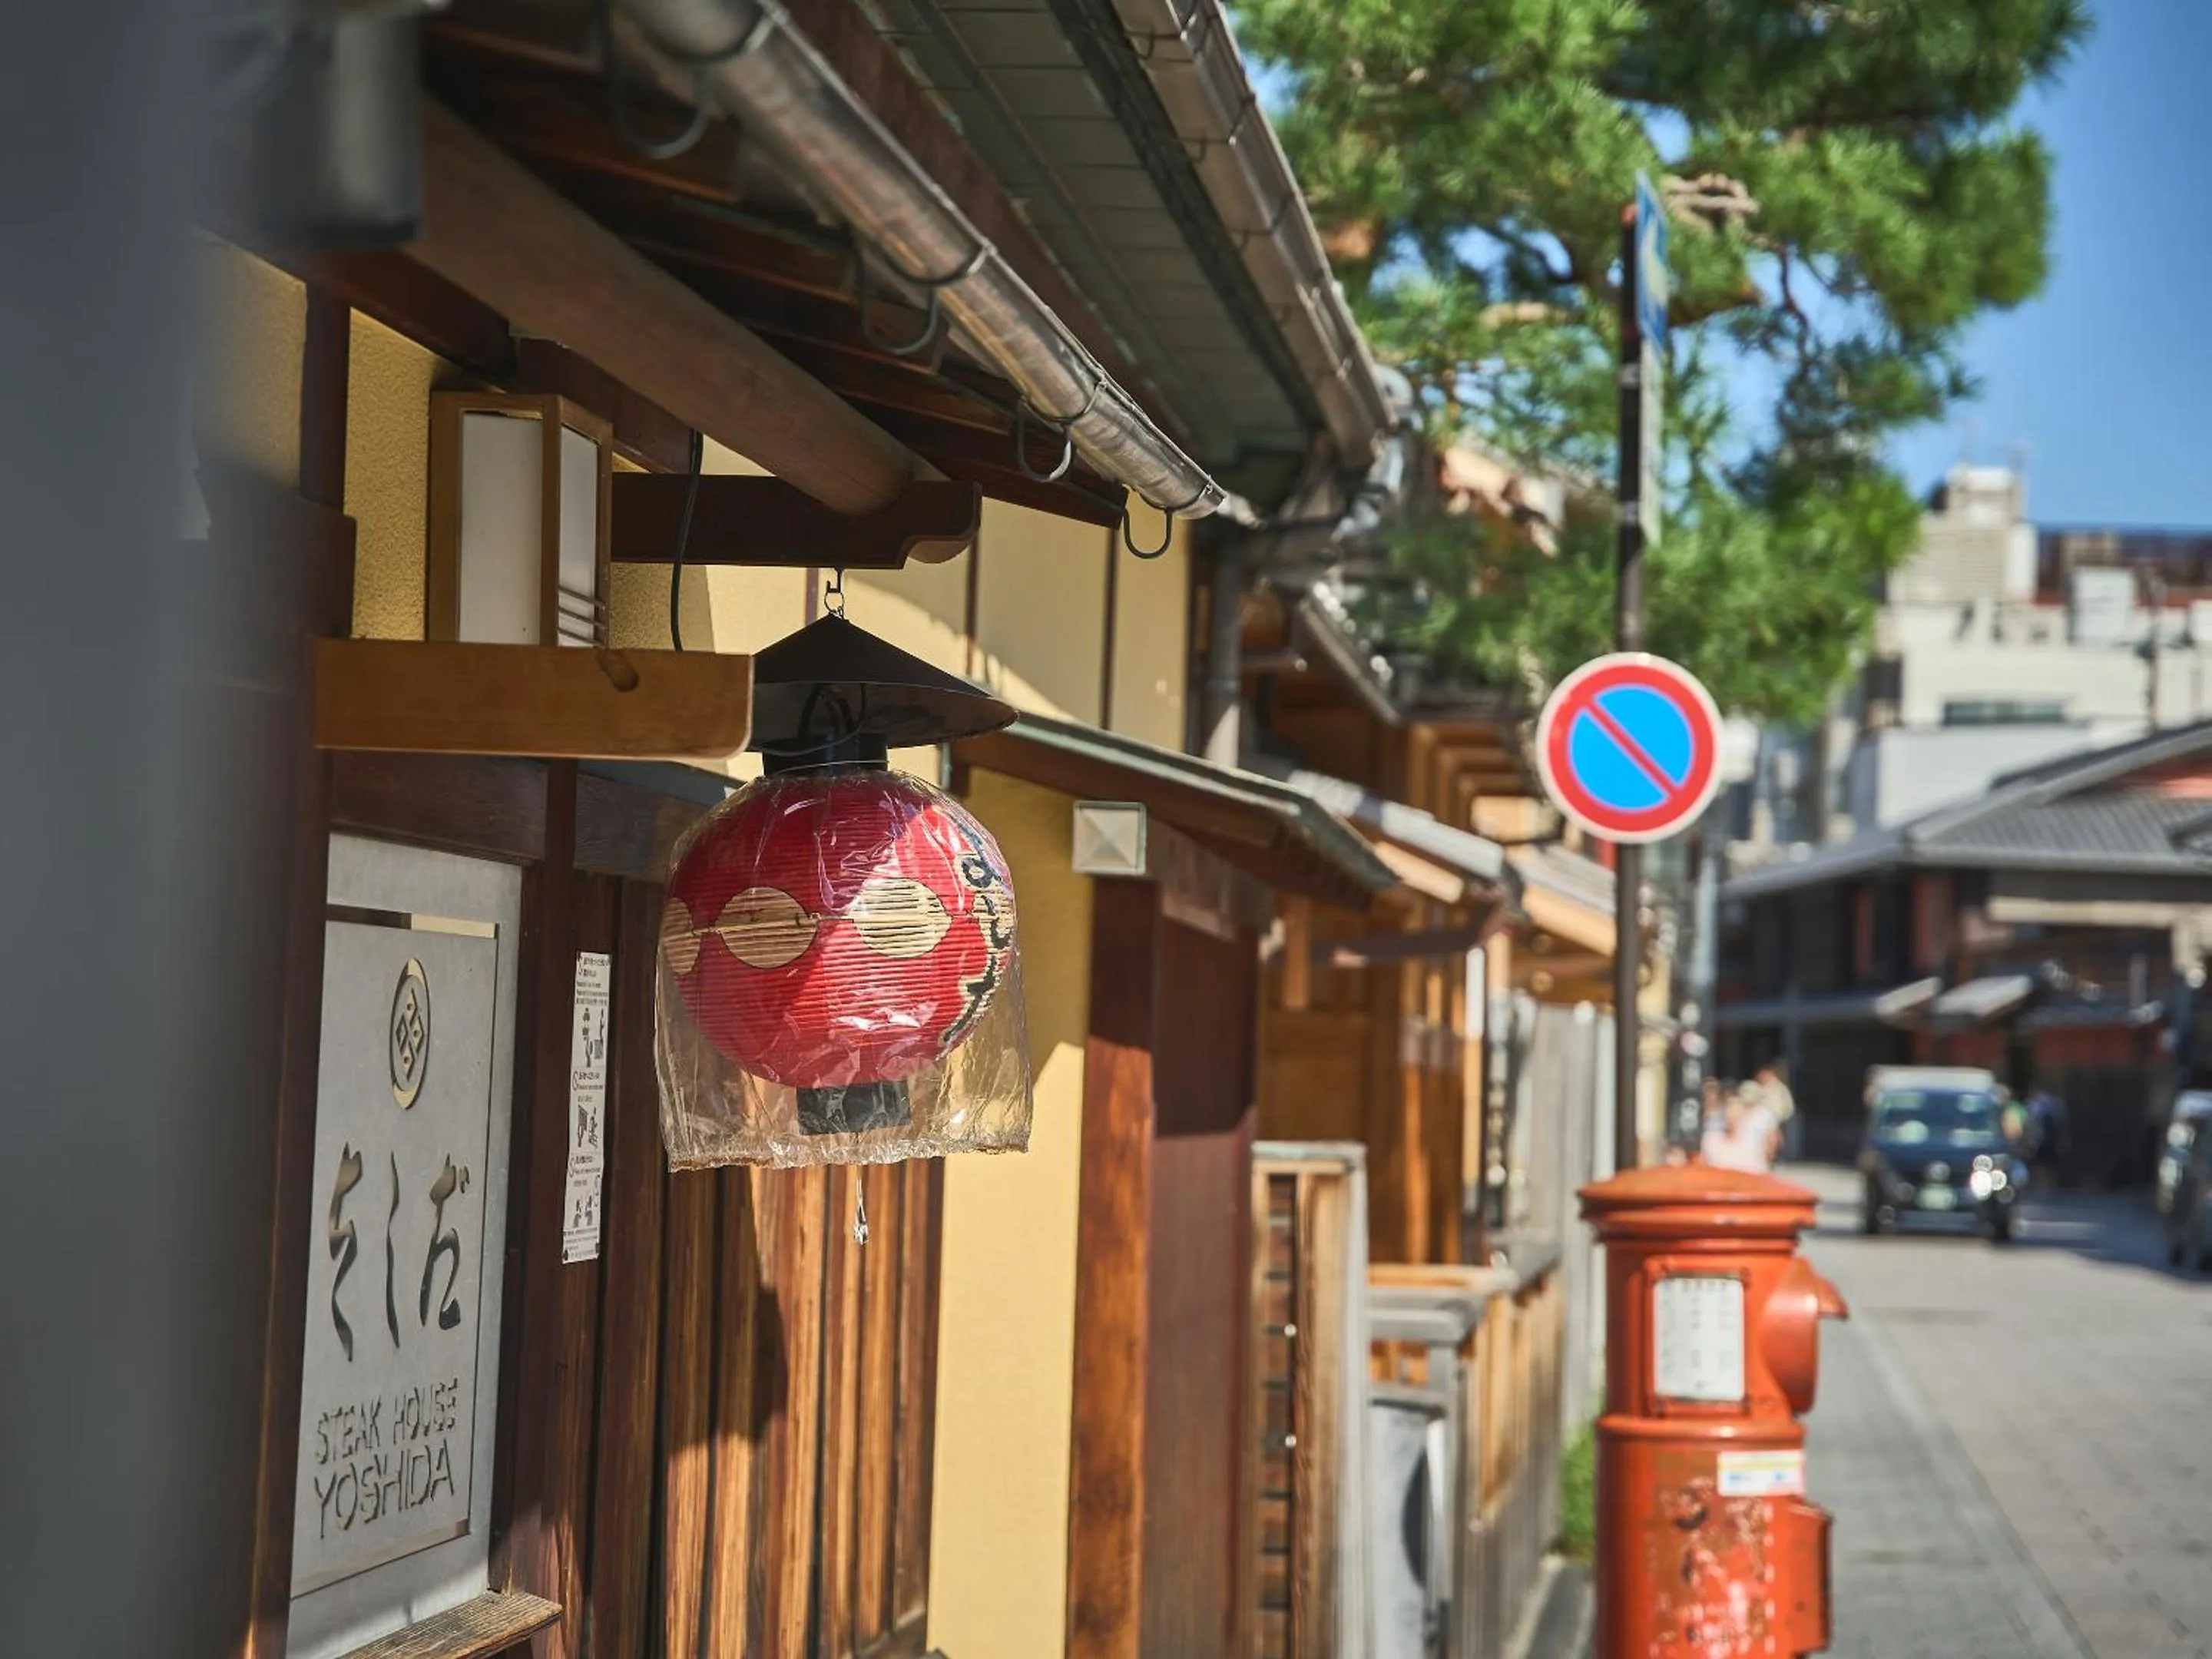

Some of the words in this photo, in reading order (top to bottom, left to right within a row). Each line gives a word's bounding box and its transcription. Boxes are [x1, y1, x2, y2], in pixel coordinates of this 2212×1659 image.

[316, 1395, 382, 1465] STEAK
[393, 1378, 458, 1445] HOUSE
[314, 1438, 455, 1539] YOSHIDA
